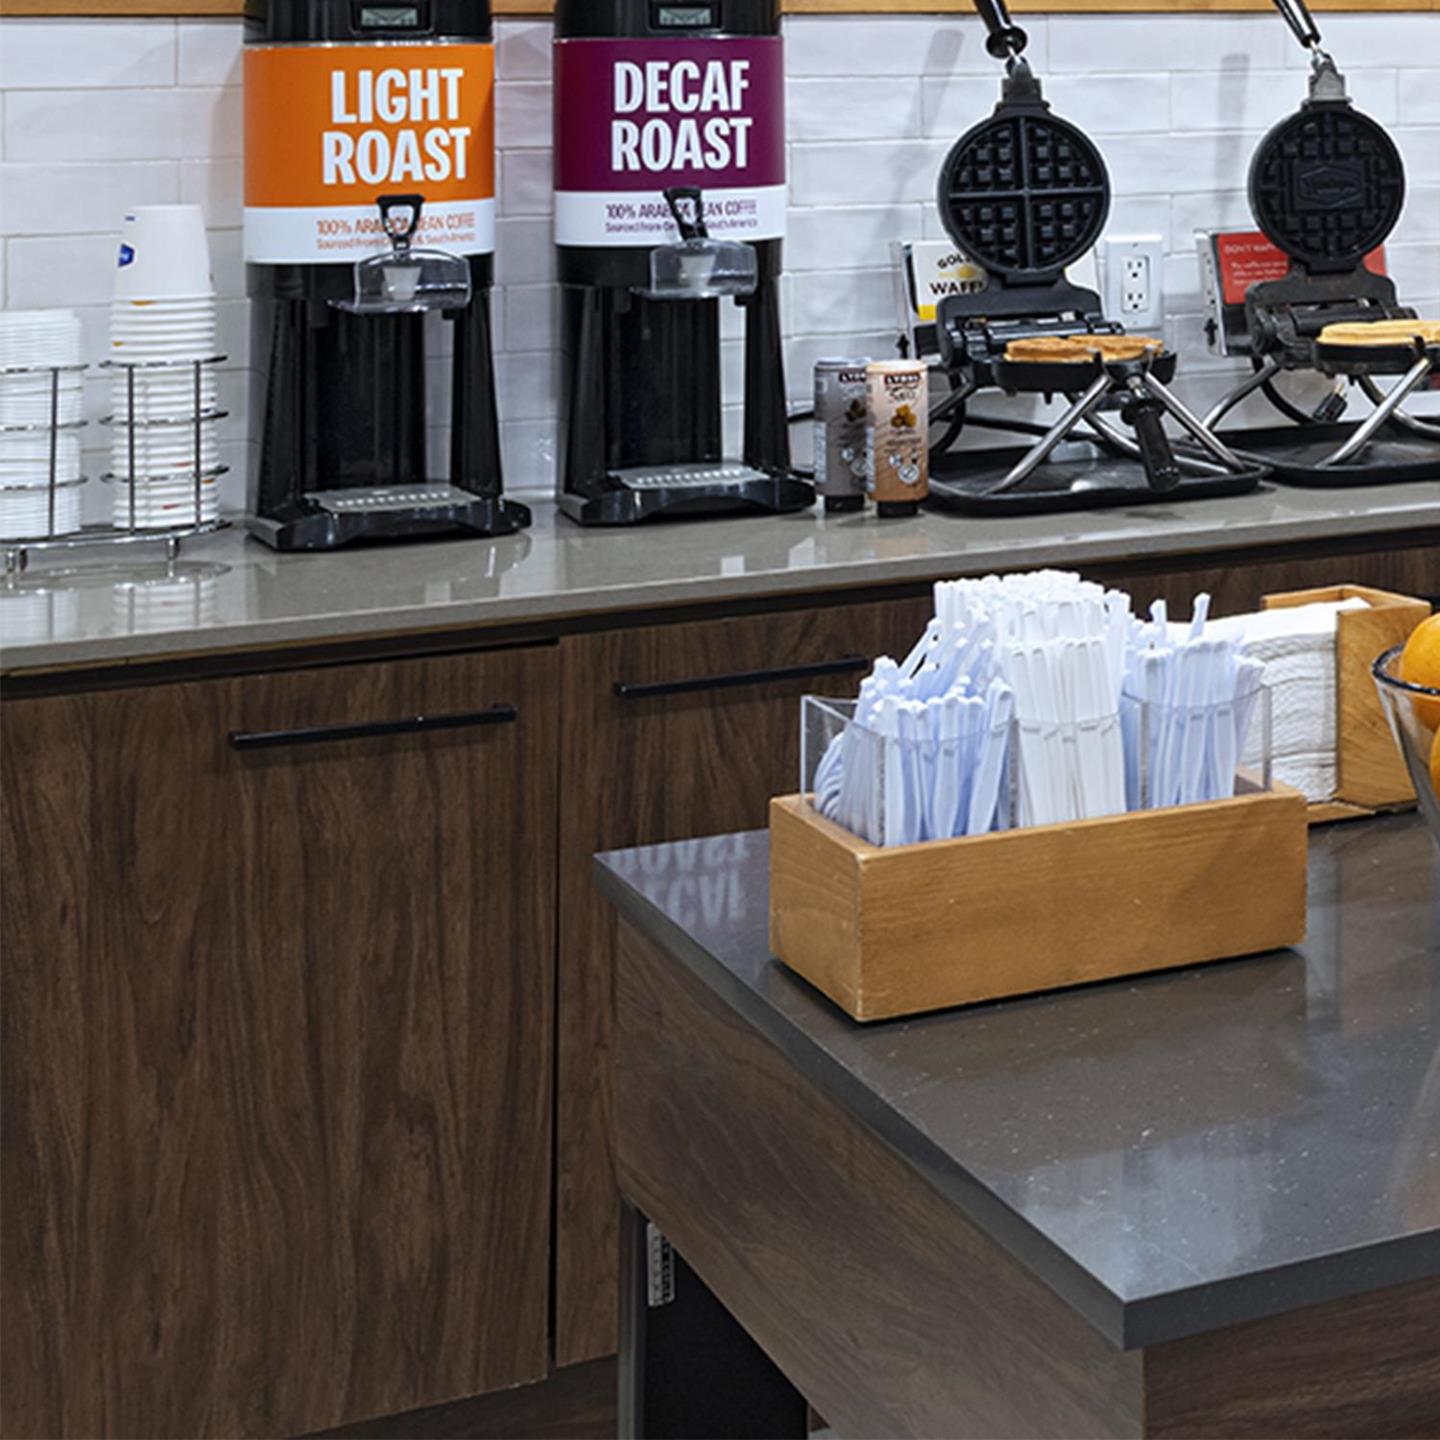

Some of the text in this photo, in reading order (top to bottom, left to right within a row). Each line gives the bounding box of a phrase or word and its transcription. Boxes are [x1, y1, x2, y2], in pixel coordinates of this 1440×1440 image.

[331, 68, 464, 124] LIGHT
[614, 60, 749, 113] DECAF
[322, 127, 471, 185] ROAST
[611, 118, 753, 171] ROAST
[317, 219, 351, 236] 100%
[605, 204, 636, 220] 100%
